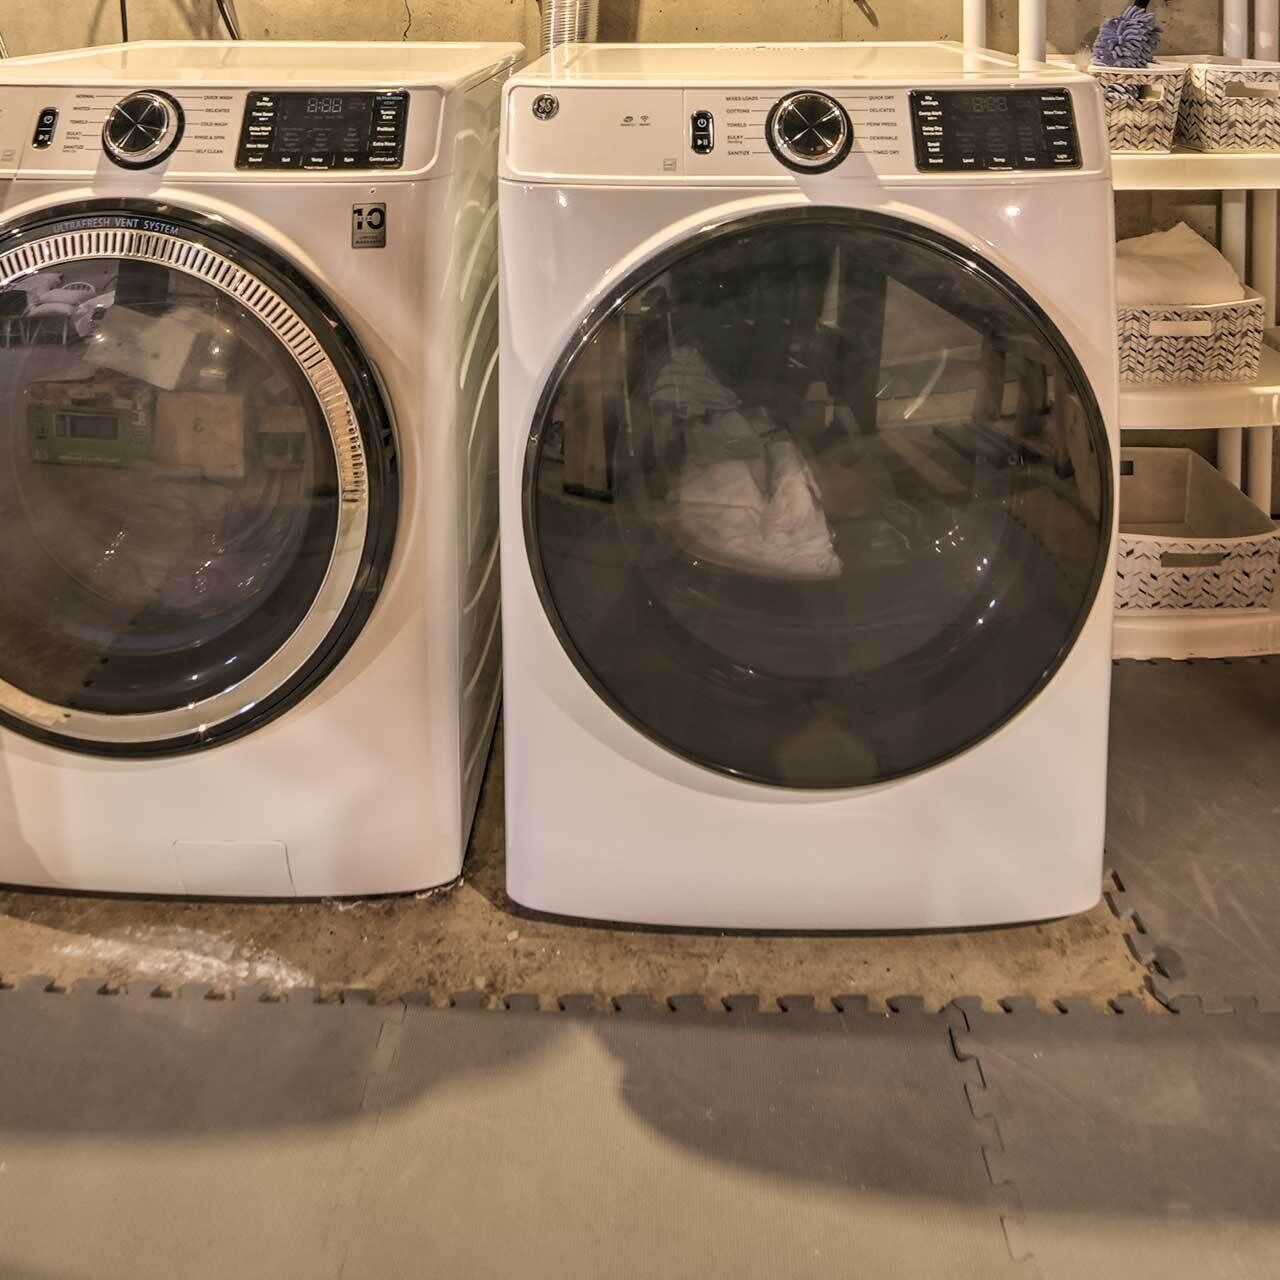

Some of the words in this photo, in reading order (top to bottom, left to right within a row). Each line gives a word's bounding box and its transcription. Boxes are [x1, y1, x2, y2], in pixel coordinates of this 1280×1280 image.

[53, 217, 110, 232] ULTRAFRESH
[115, 218, 138, 228] VENT
[143, 220, 179, 235] SYSTEM
[353, 208, 385, 230] 10
